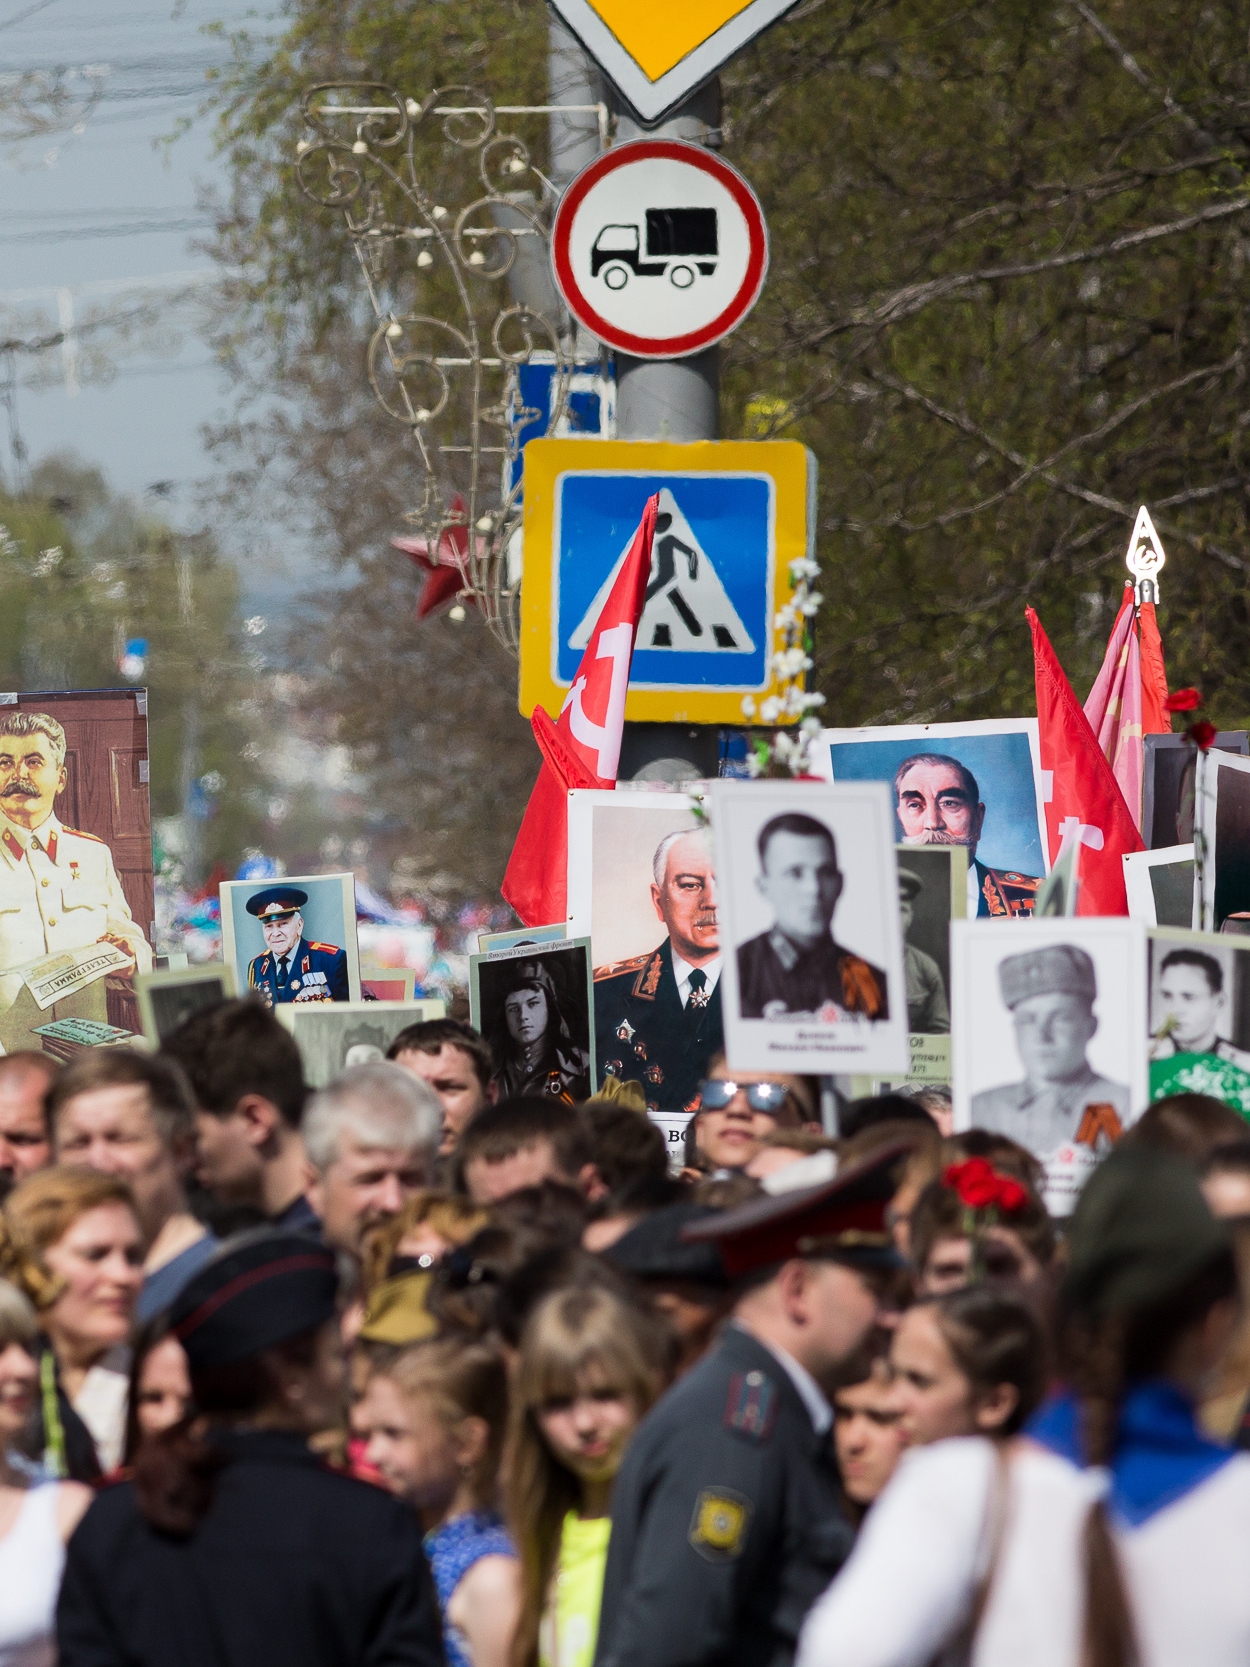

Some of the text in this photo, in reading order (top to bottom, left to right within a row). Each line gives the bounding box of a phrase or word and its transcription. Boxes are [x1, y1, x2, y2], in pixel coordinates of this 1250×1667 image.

[487, 940, 573, 960] Второй Украинский фронт
[53, 957, 107, 988] ТЕЛЕГРАММА
